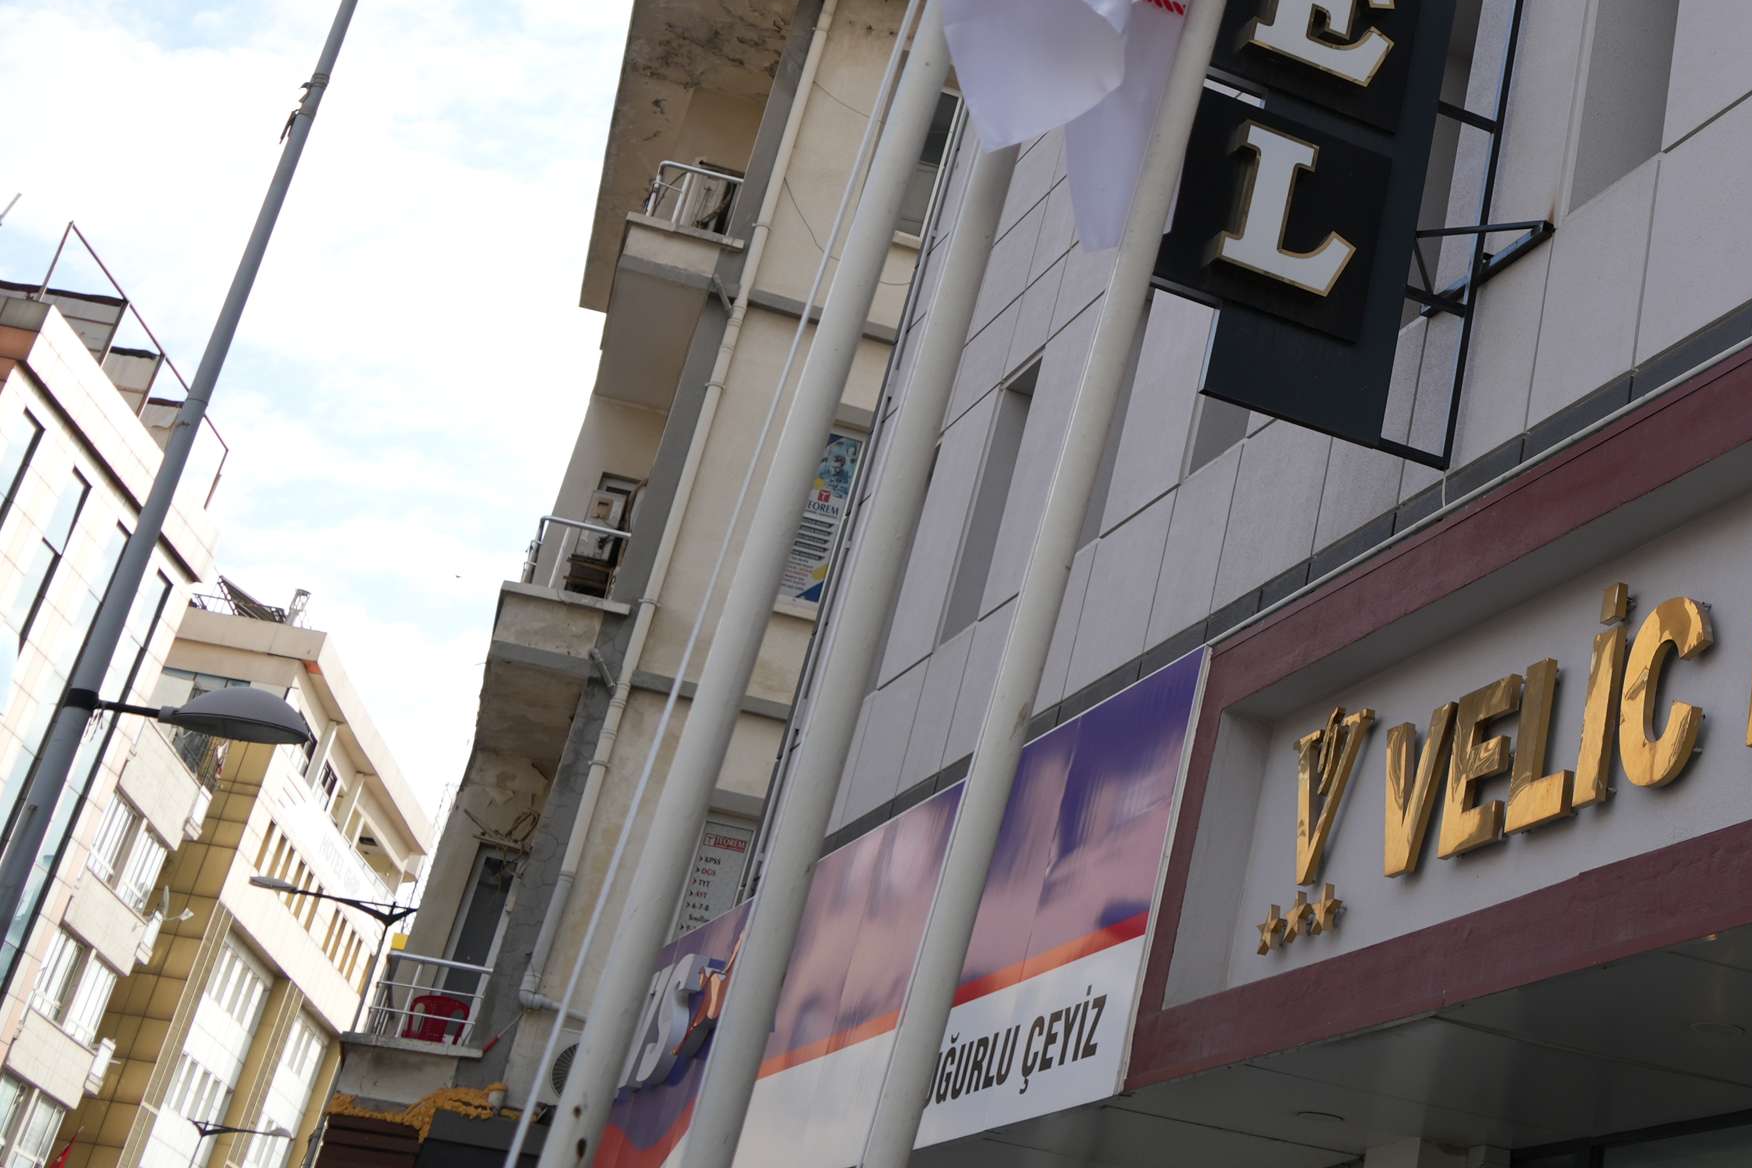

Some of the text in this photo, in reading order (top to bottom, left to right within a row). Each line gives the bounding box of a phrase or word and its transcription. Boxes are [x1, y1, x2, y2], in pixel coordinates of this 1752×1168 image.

[807, 500, 839, 516] EOREM
[1384, 580, 1712, 879] VELİC
[1018, 984, 1108, 1095] ÇEYİZ
